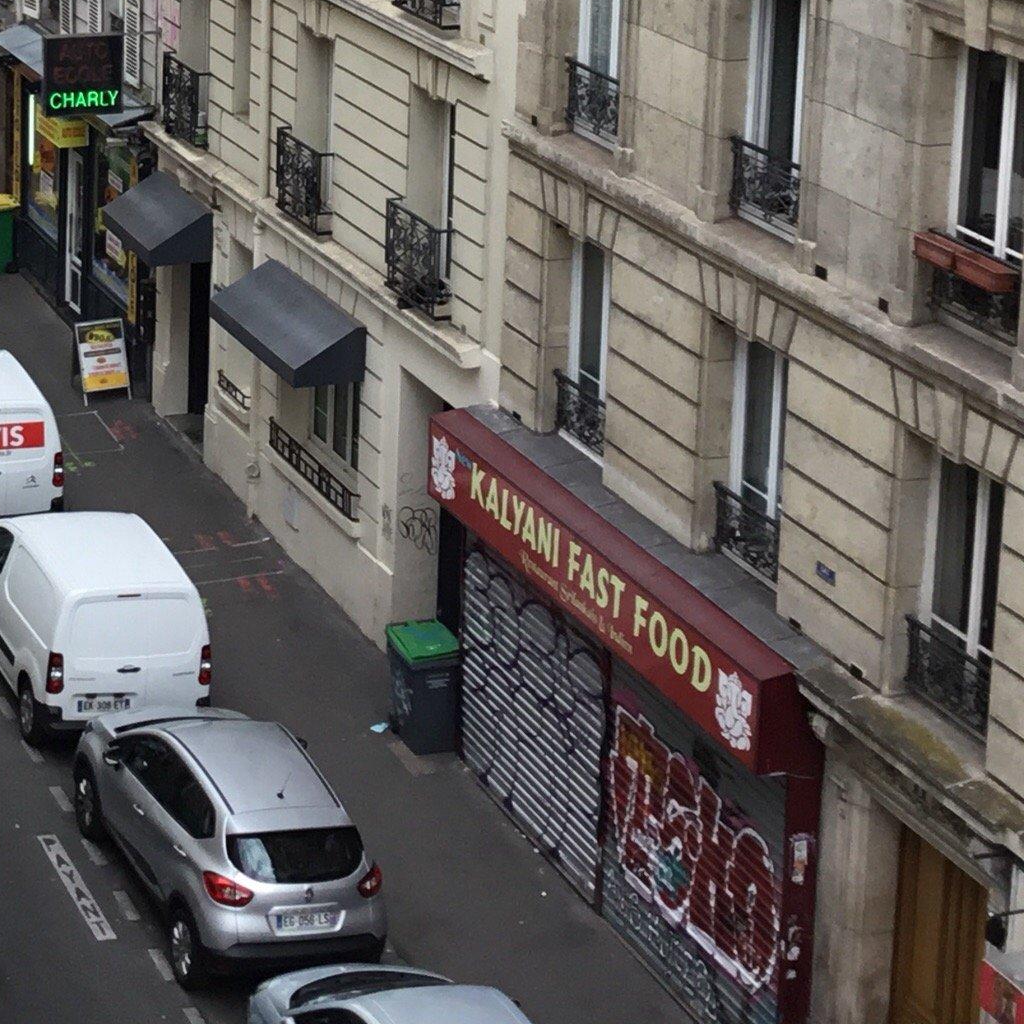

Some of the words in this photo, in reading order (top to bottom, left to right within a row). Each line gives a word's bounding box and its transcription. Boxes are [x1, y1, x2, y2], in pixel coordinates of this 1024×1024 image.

[49, 90, 119, 109] CHARLY
[471, 462, 560, 568] KALYANI
[567, 540, 626, 619] FAST
[632, 594, 712, 693] FOOD
[40, 837, 108, 938] PAYANT
